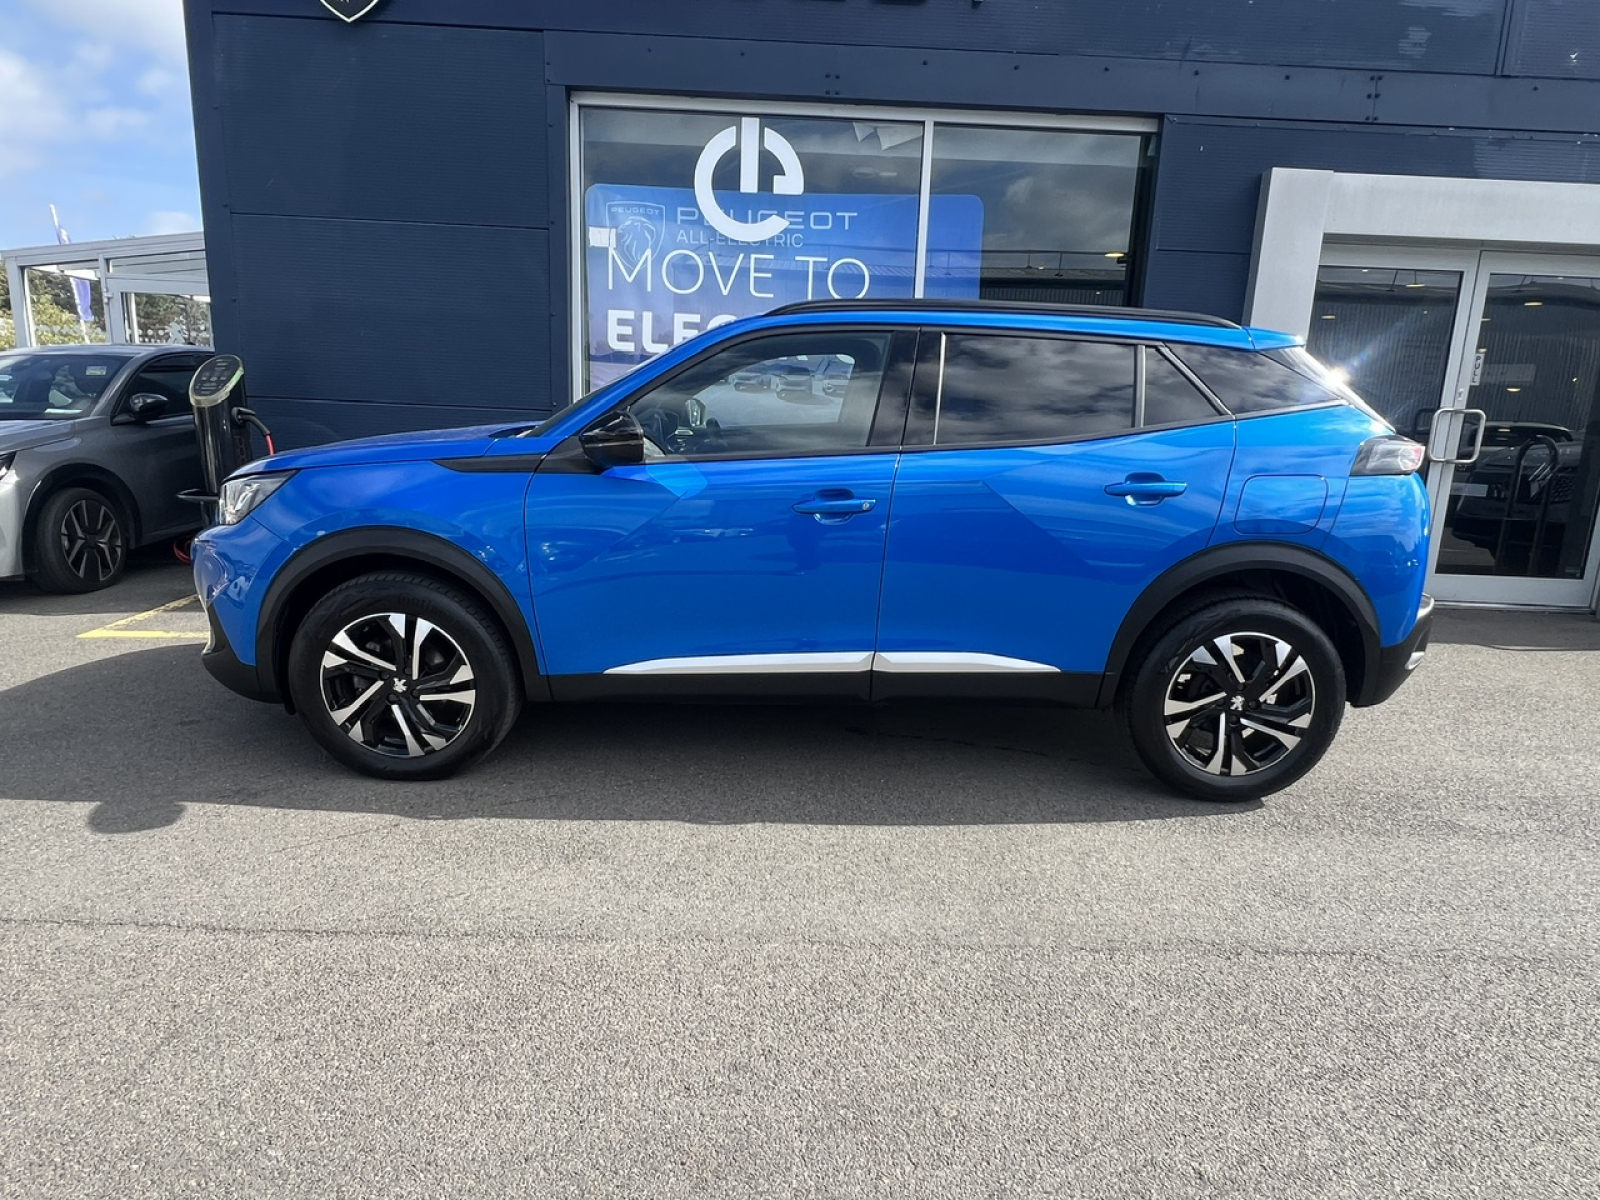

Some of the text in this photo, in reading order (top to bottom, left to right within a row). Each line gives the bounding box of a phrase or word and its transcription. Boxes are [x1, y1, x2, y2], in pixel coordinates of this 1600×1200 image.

[611, 206, 660, 216] PEUGEOT
[677, 206, 858, 231] PUEOT
[608, 247, 870, 301] MOVE TO
[1472, 355, 1481, 383] PULL
